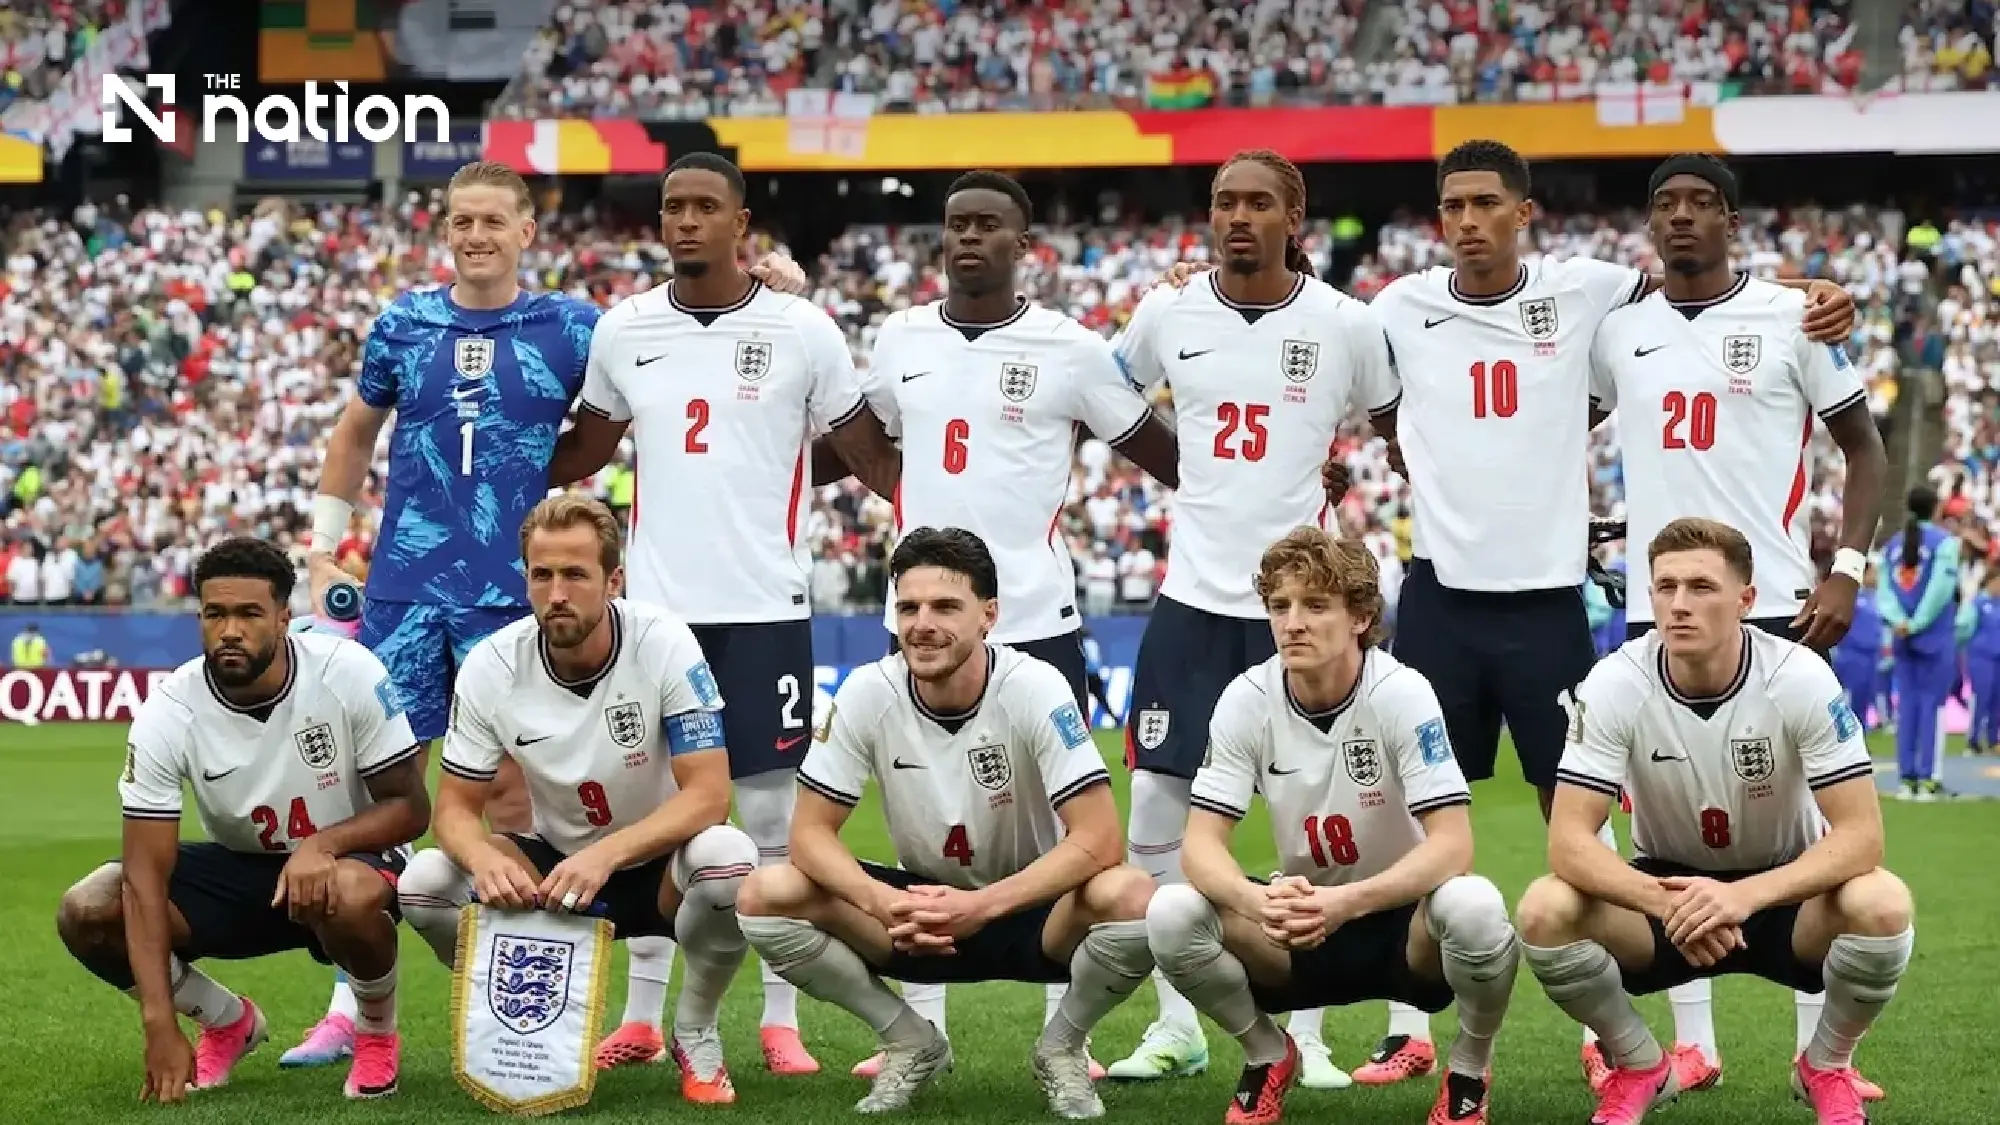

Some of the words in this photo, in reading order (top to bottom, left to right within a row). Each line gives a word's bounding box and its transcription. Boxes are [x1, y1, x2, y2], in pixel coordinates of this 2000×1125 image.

[1469, 360, 1517, 419] 10
[685, 399, 709, 453] 2
[943, 419, 968, 474] 6
[1213, 402, 1269, 461] 25
[1663, 391, 1716, 451] 20
[460, 422, 473, 476] 1
[777, 674, 803, 729] 2
[251, 797, 317, 850] 24
[578, 781, 612, 826] 9
[1701, 808, 1731, 849] 8
[943, 823, 974, 866] 4
[1305, 814, 1359, 868] 18
